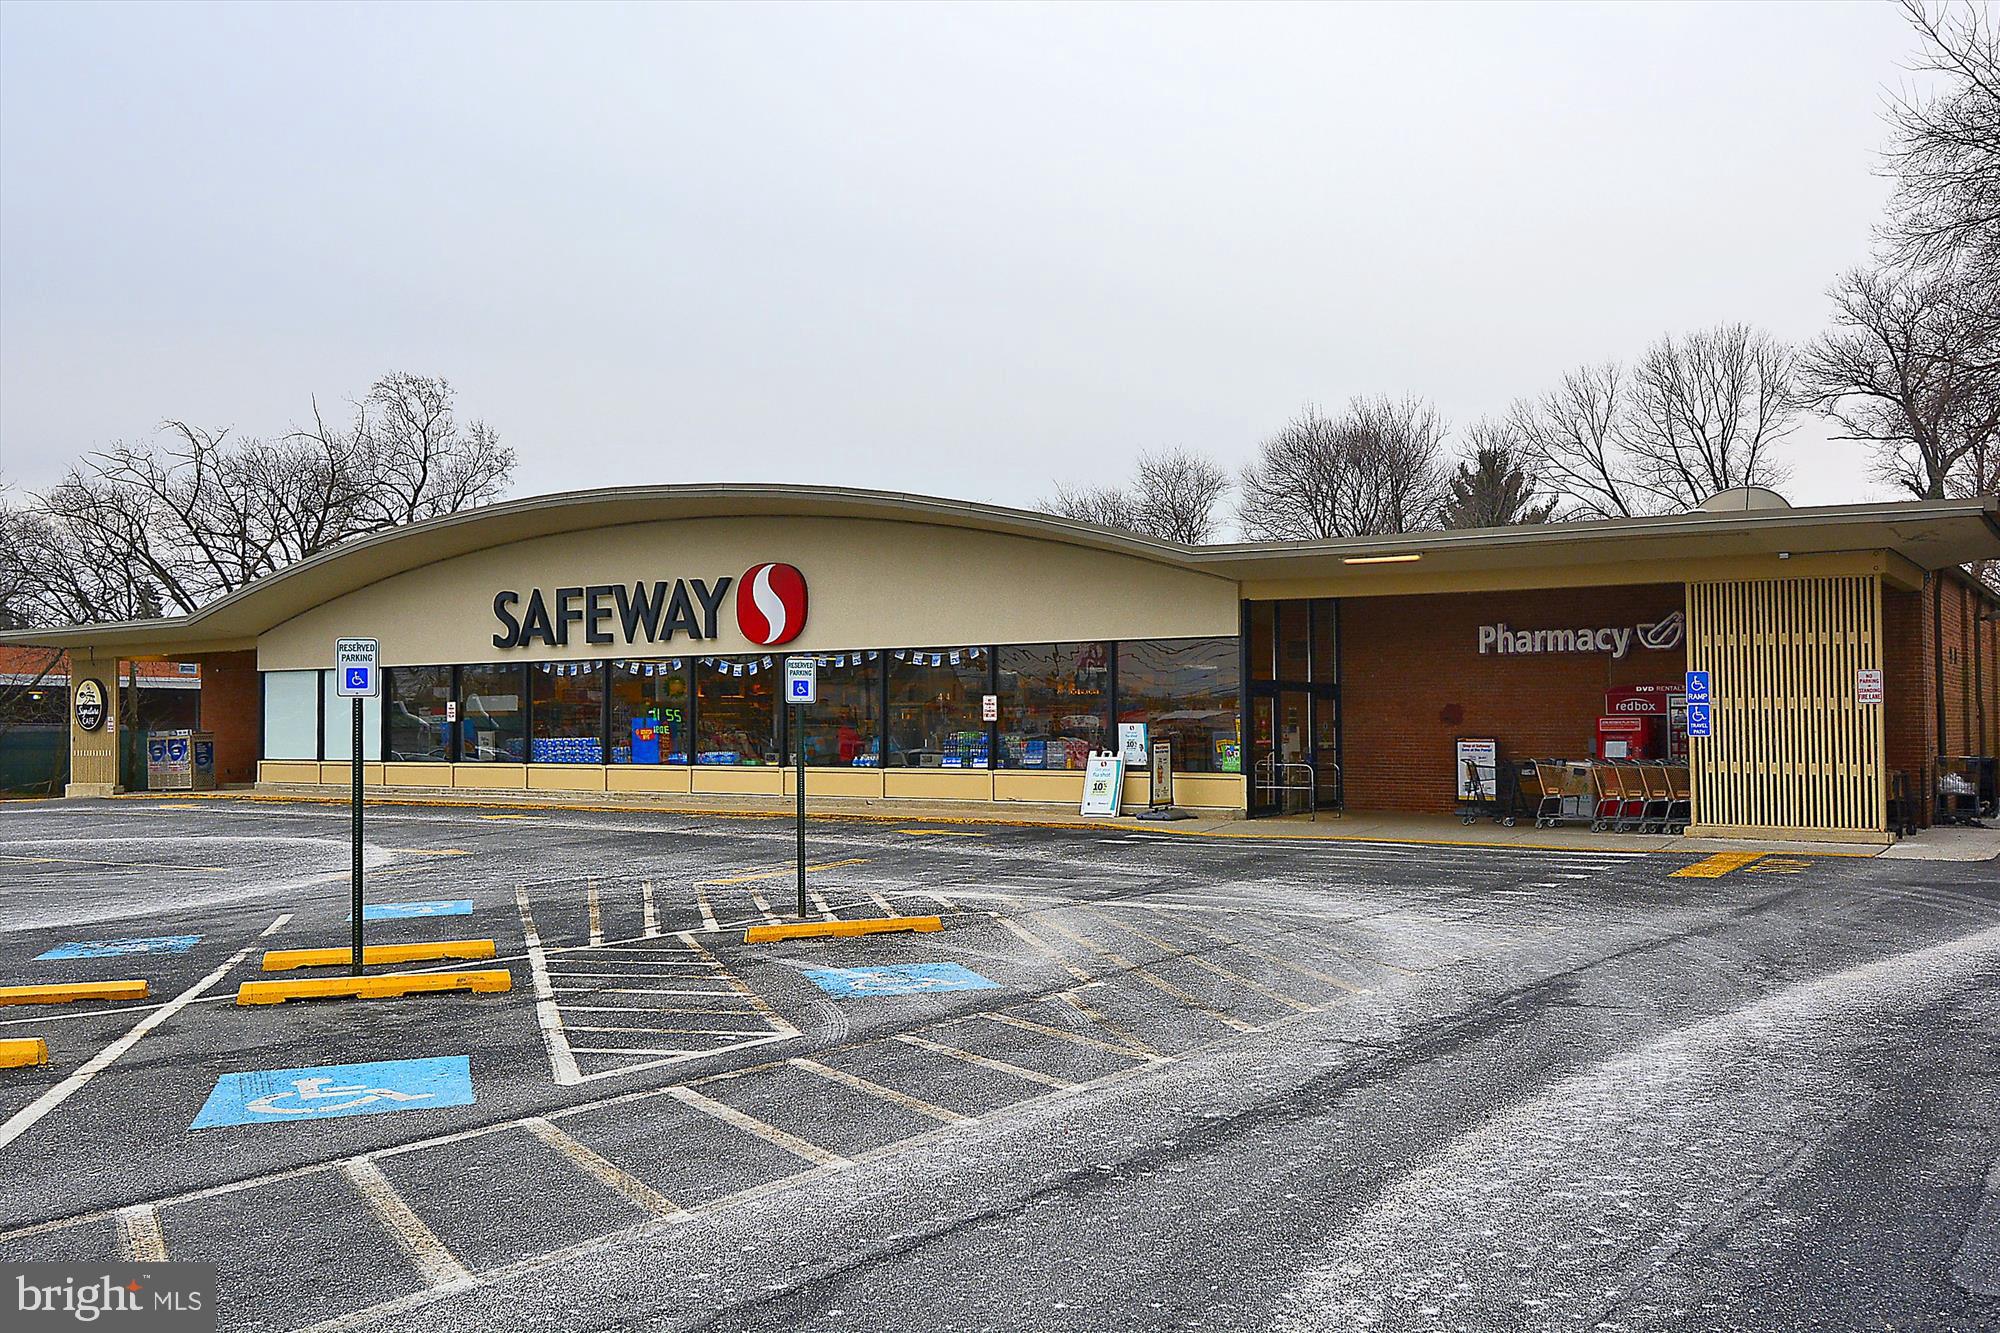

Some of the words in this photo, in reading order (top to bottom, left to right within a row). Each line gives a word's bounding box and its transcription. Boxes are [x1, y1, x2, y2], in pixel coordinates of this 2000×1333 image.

[492, 577, 732, 648] SAFEWAY
[1479, 623, 1630, 658] Pharmacy
[1615, 700, 1656, 711] redbox
